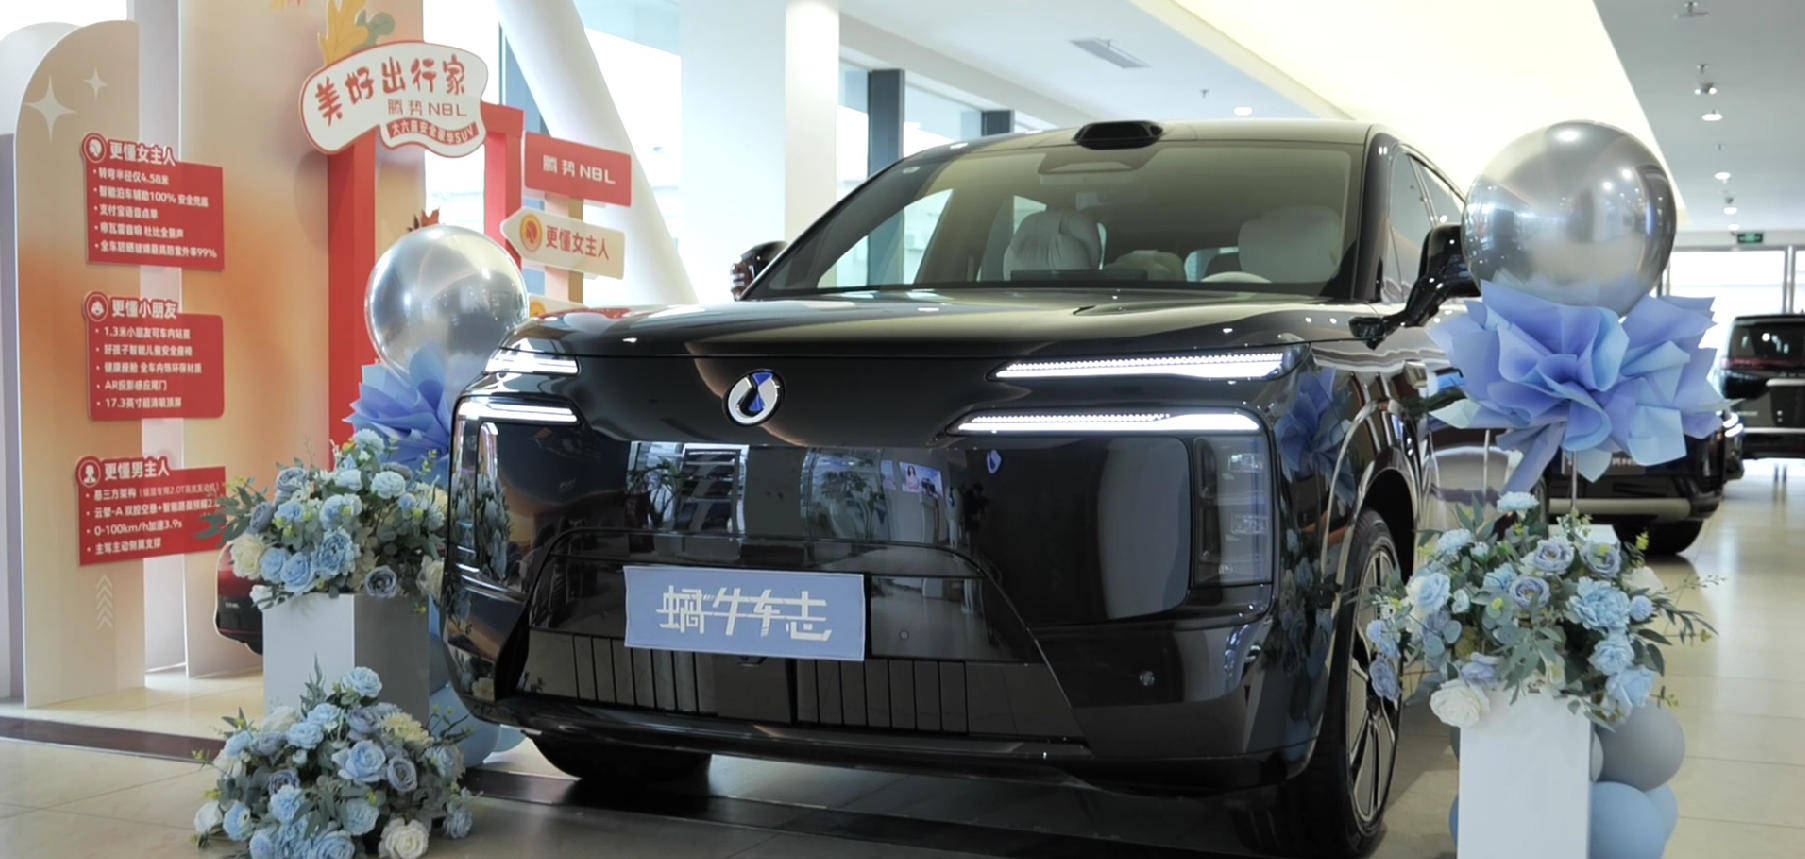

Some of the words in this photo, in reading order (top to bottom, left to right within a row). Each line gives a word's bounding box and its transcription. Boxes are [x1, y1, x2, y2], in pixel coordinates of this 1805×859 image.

[314, 54, 465, 127] 美好出行家
[109, 140, 177, 167] 更懂女主人
[546, 225, 610, 261] 更懂女主人
[111, 298, 177, 320] 更懂小朋友
[104, 459, 170, 481] 更懂男主人
[93, 519, 183, 536] 0-100km/h加速3.9s
